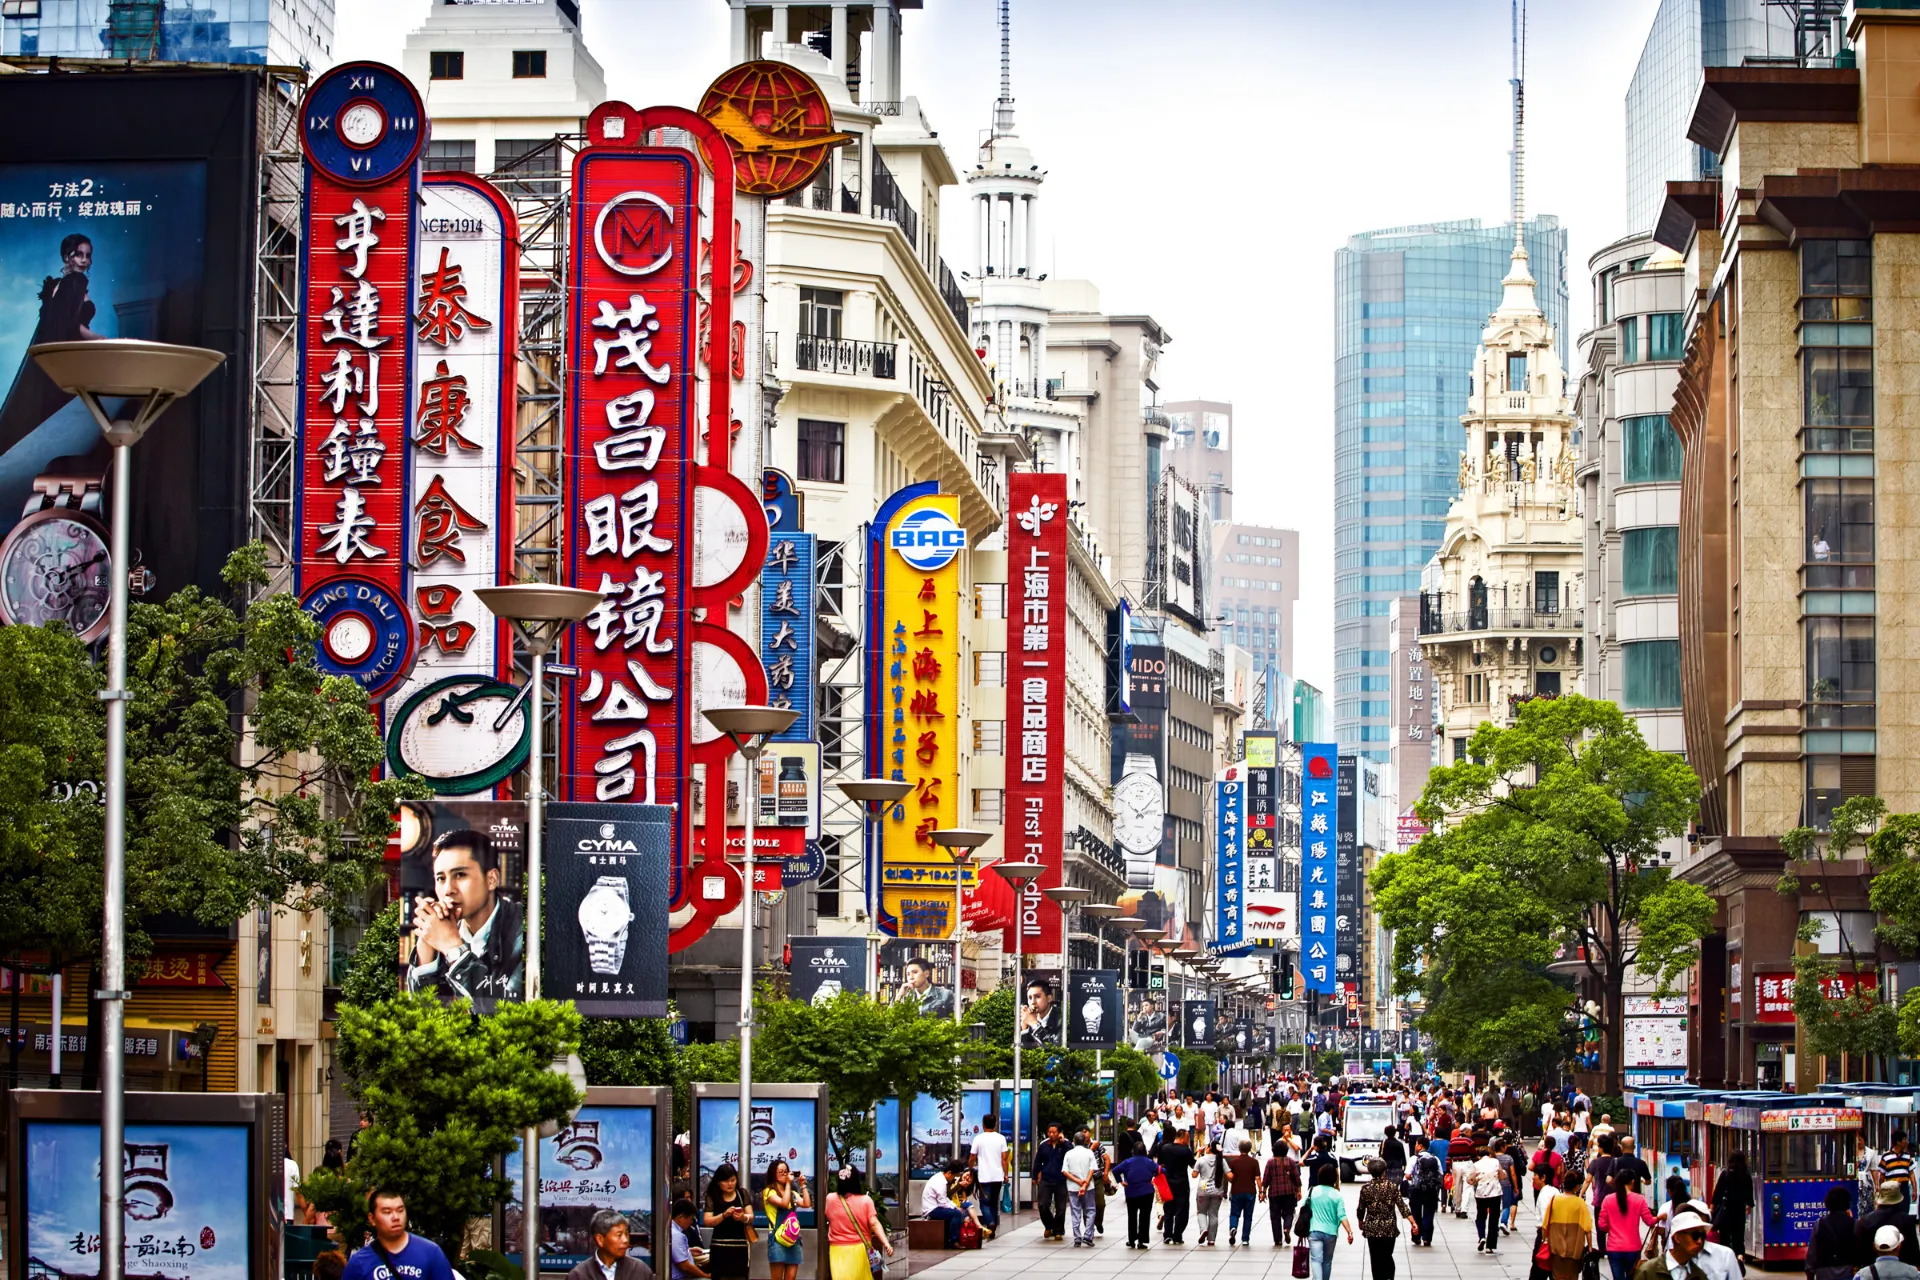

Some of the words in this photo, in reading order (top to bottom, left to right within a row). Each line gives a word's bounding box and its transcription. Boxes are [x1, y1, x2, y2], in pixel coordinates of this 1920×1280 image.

[0, 200, 153, 219] 随心而行，绽放瑰丽。
[415, 246, 493, 655] 泰康食品
[892, 530, 965, 547] BAC
[580, 294, 674, 805] 茂昌眼镜公司
[356, 586, 397, 621] DALI
[361, 631, 400, 683] WATCHES
[1022, 545, 1050, 783] 上海市第一食品商店
[1025, 797, 1043, 838] First
[578, 839, 638, 851] CYMA
[900, 899, 951, 909] SHANGHAI
[1223, 937, 1257, 953] PHARMACY
[810, 957, 848, 966] CYMA
[581, 1194, 612, 1203] Shaoxing
[141, 1256, 189, 1270] Shaoxing
